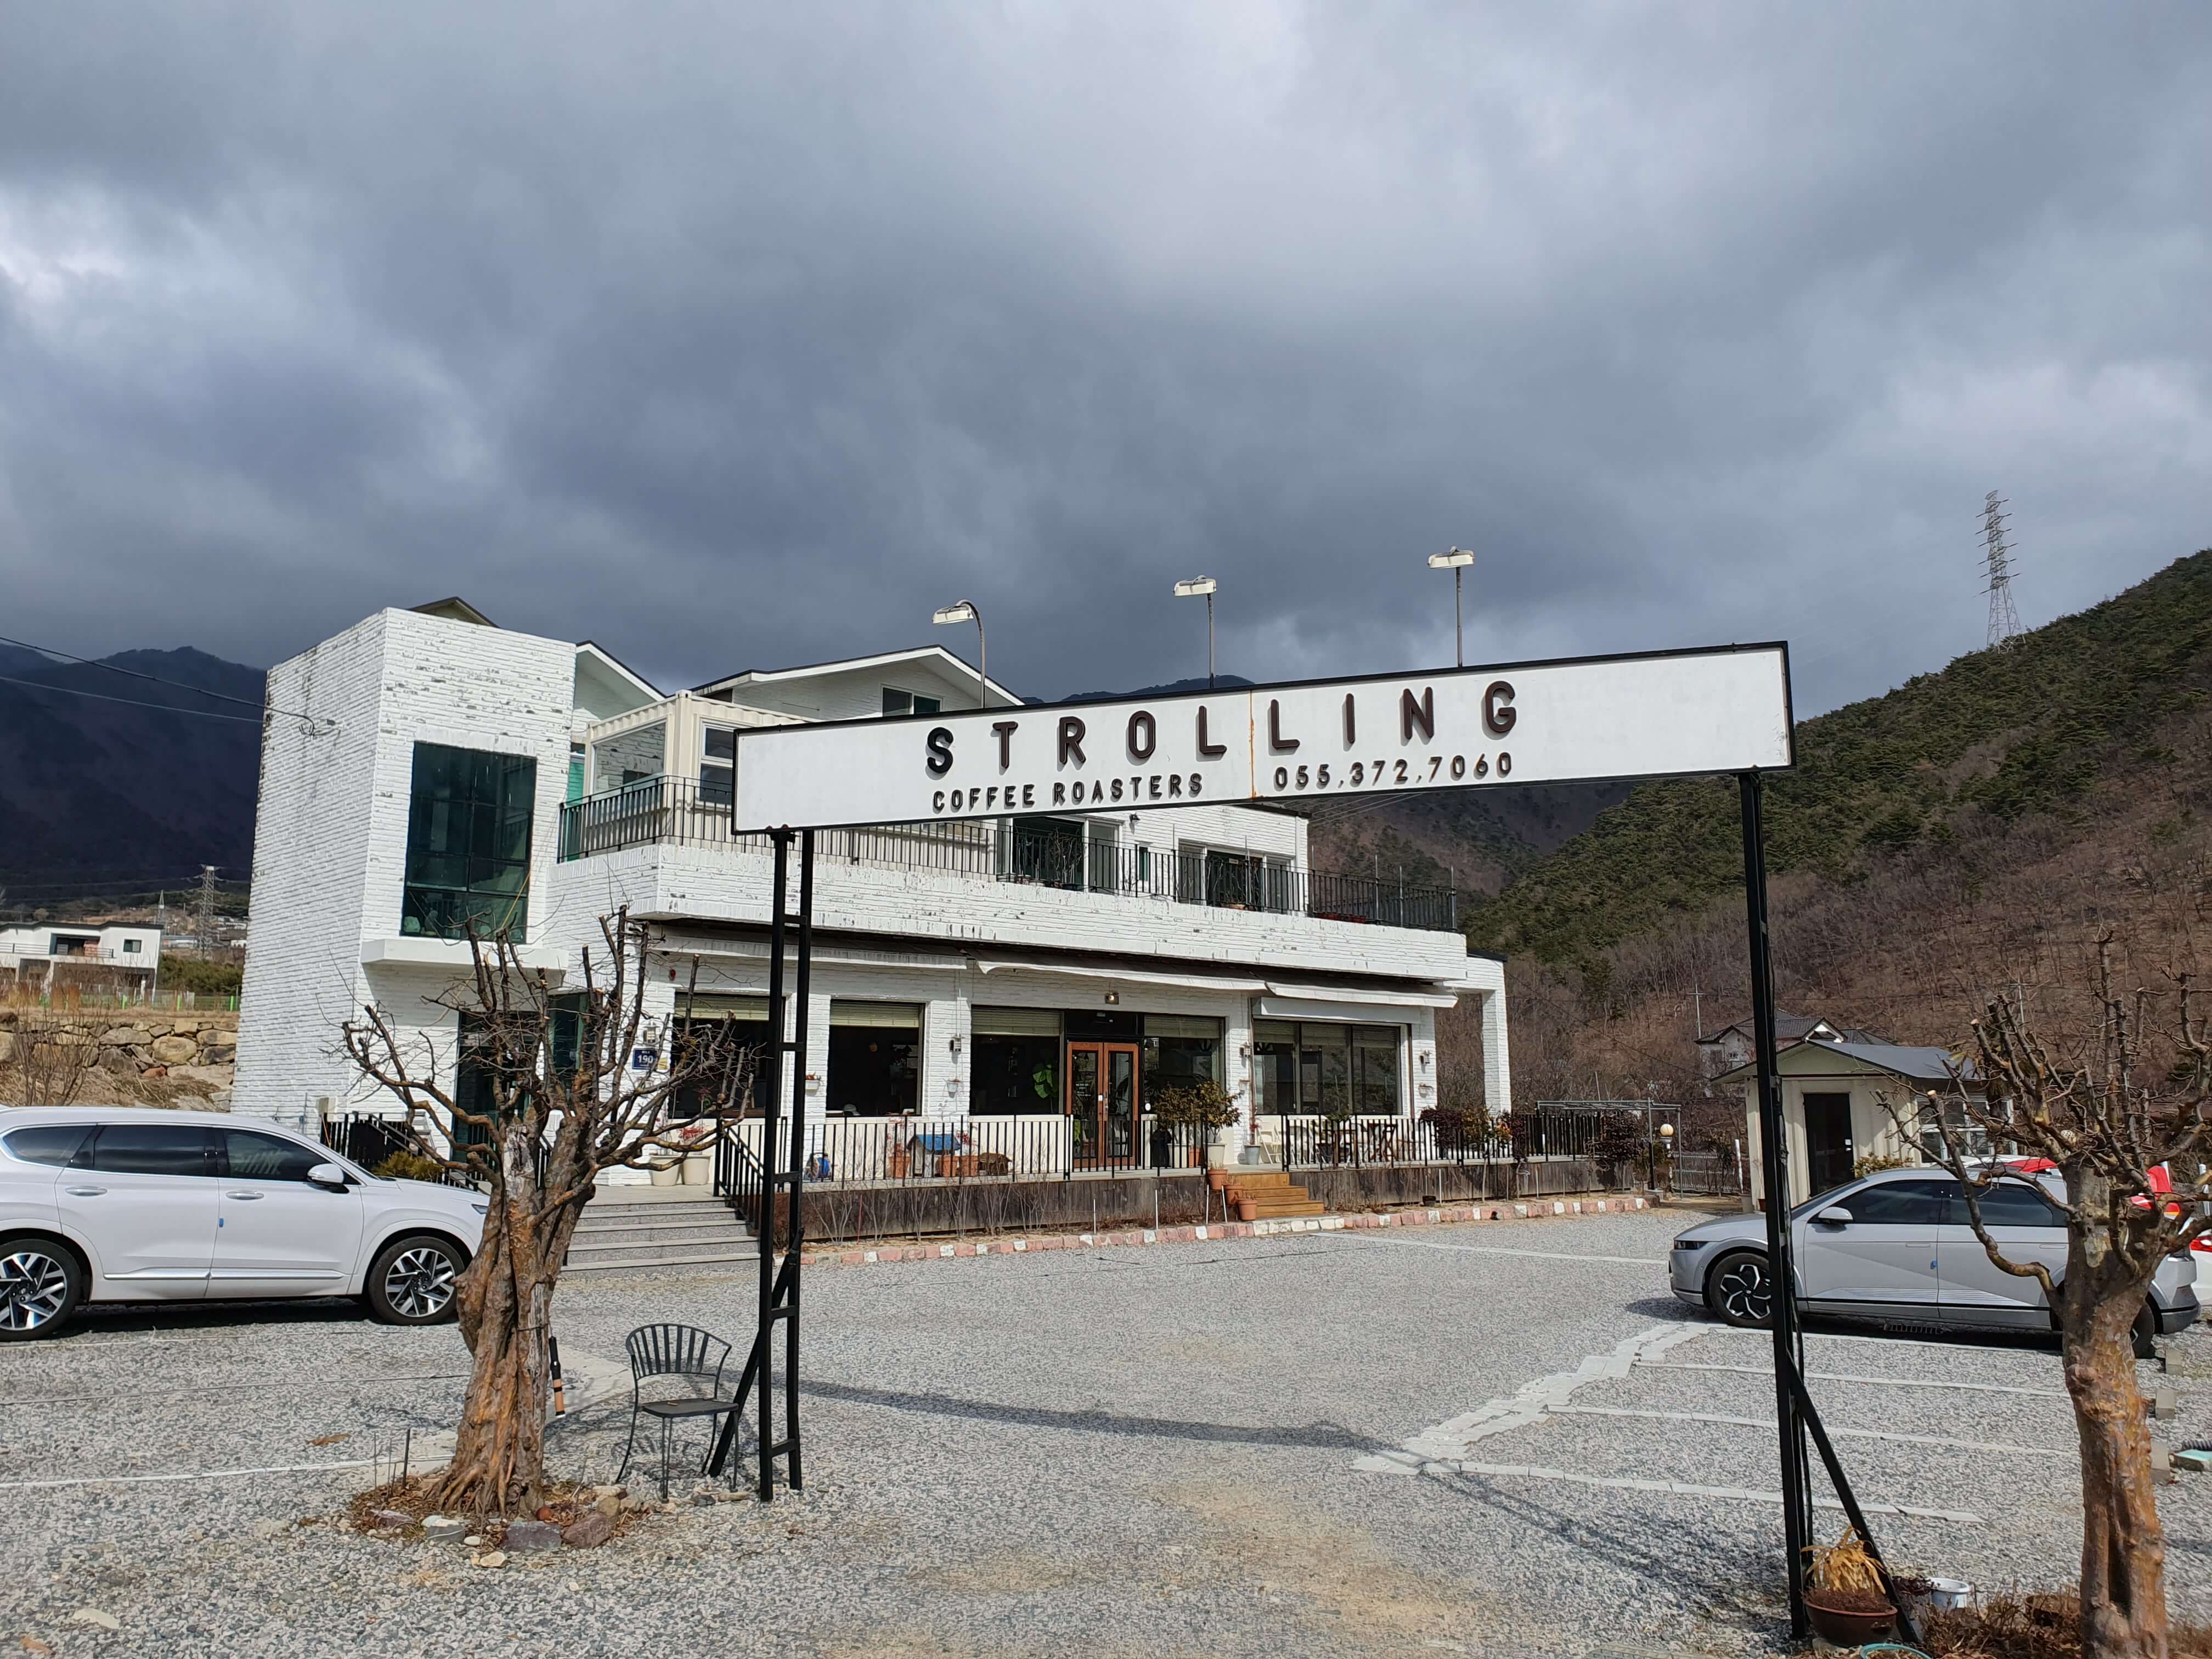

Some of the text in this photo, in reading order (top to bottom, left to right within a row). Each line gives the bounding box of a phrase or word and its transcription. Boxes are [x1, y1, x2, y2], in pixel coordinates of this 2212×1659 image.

[927, 681, 1517, 773] STROLLING
[933, 773, 1203, 810] COFFEE ROASTERS
[637, 1054, 653, 1063] 190
